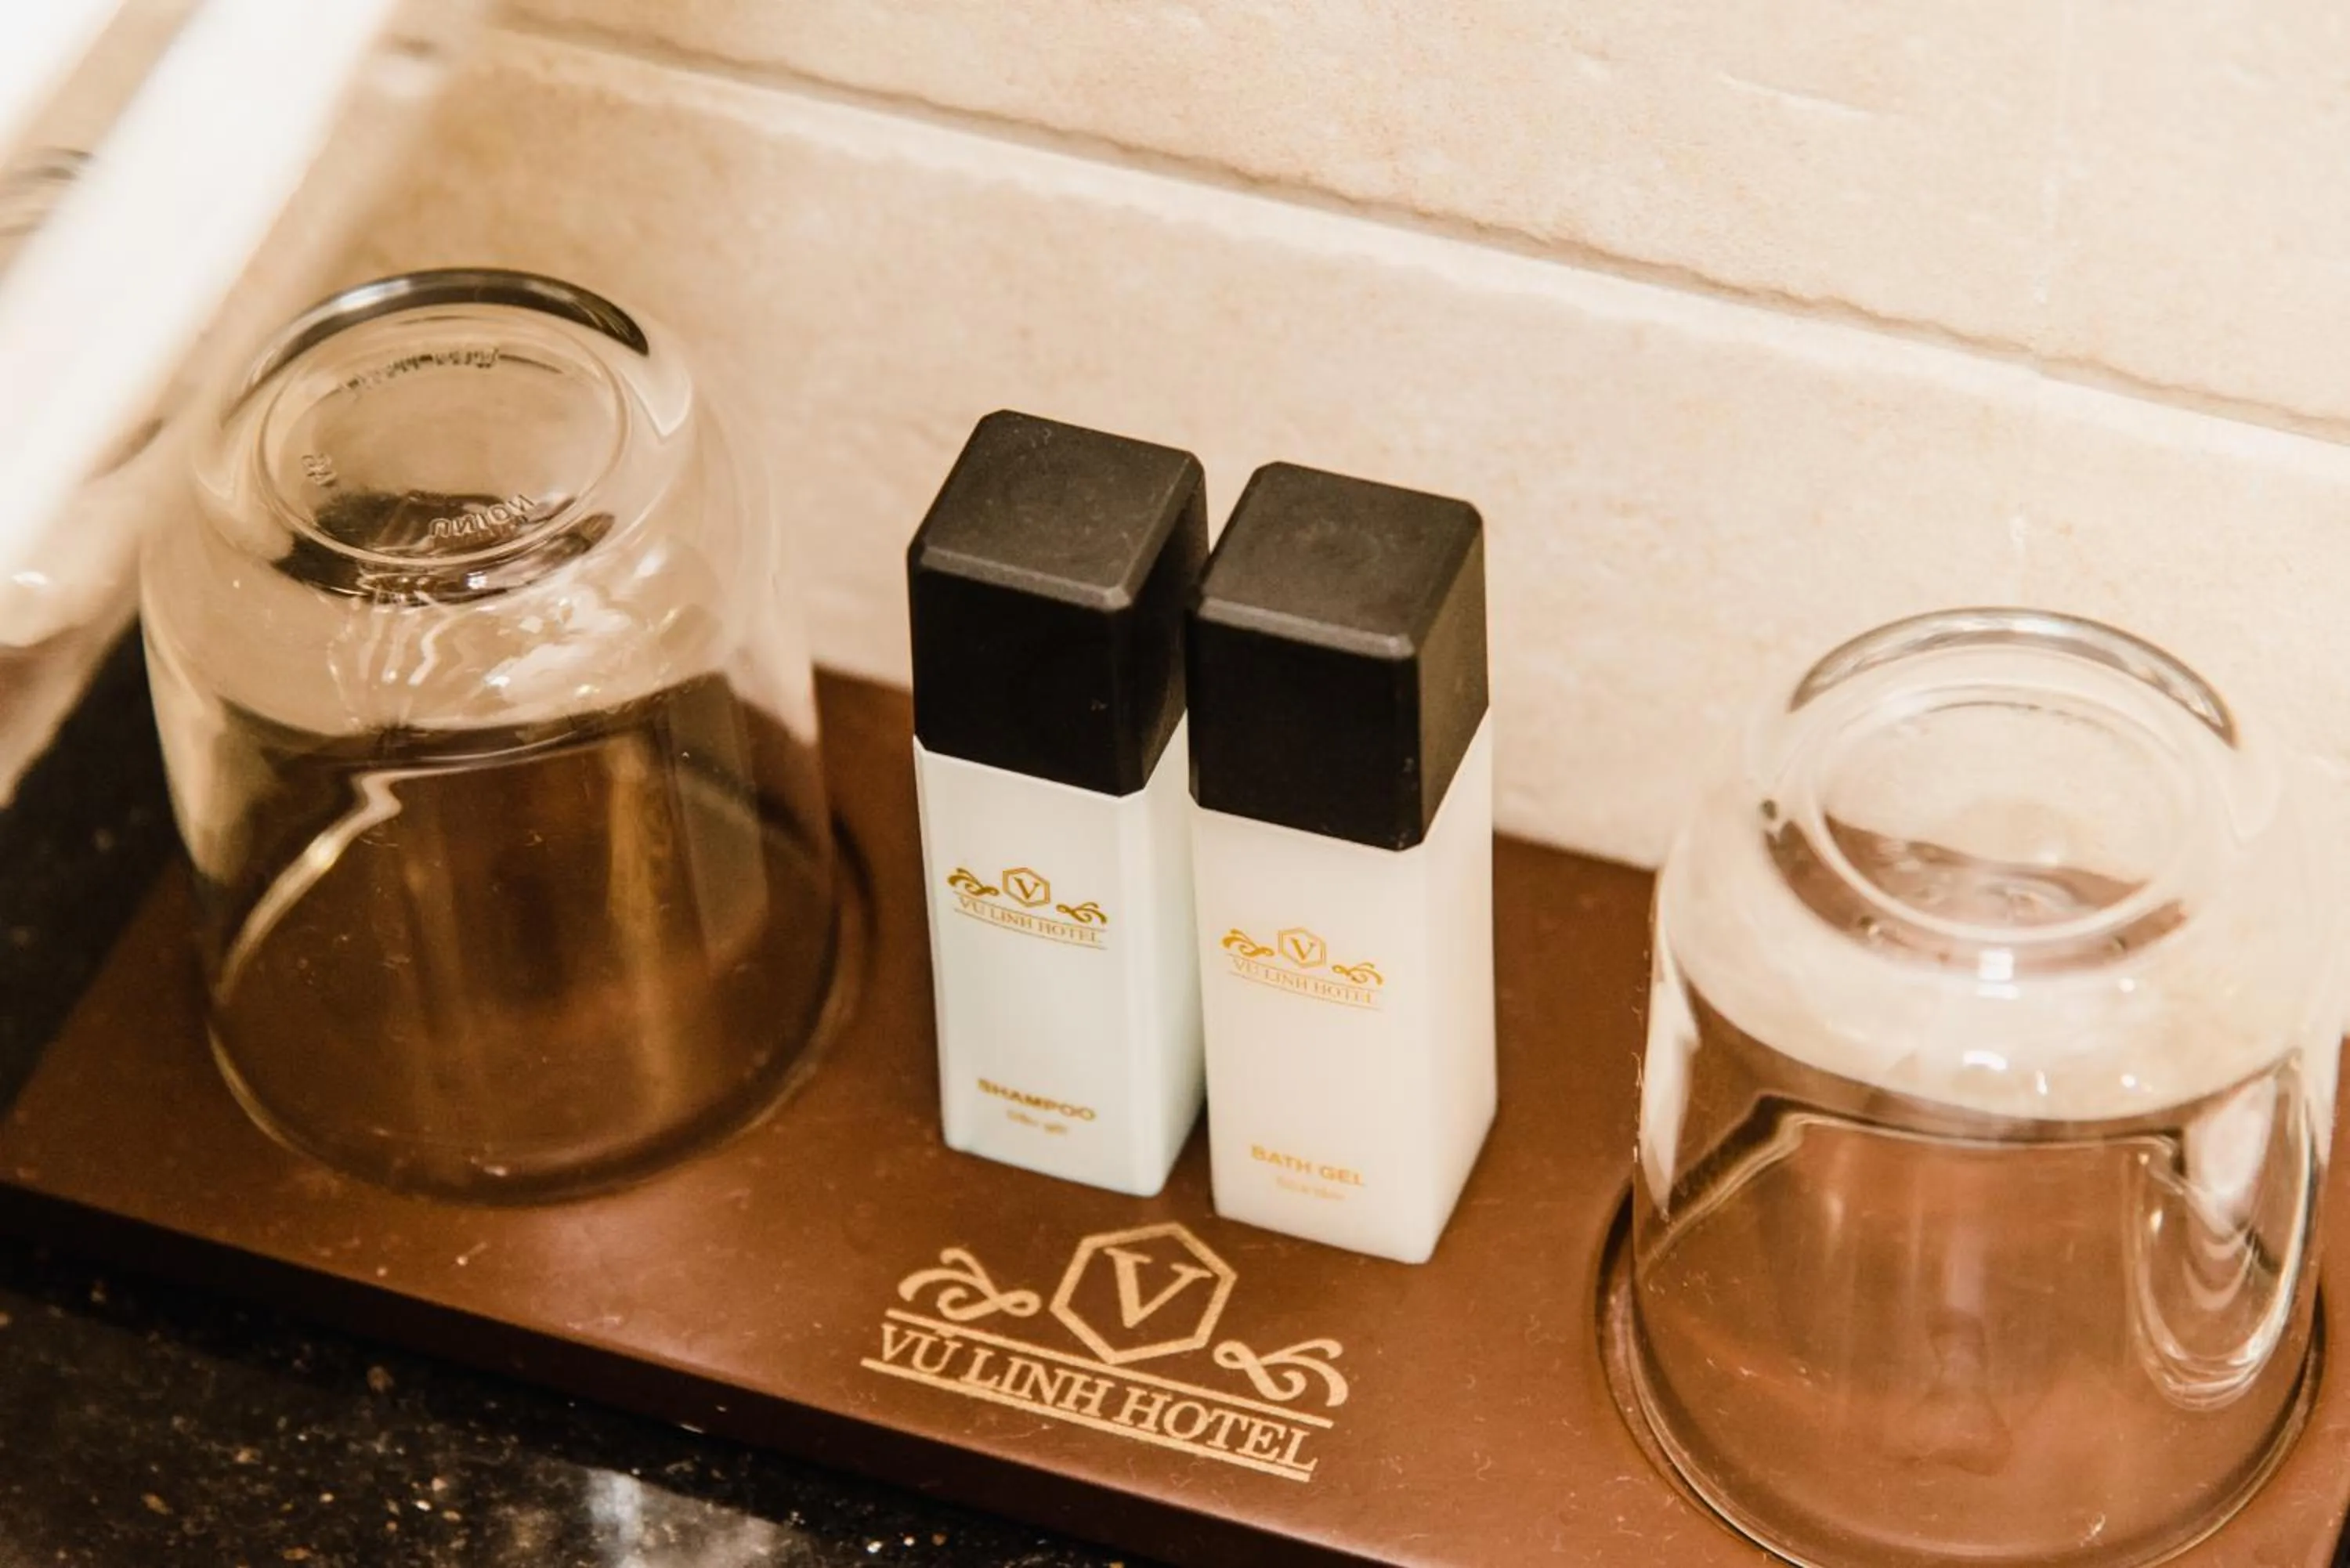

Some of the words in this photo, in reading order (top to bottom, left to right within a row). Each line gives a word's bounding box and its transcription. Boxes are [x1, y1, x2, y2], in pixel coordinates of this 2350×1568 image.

[1014, 876, 1040, 900] V
[990, 908, 1033, 929] LINH
[1038, 921, 1103, 943] HOTEL
[1290, 937, 1317, 961] V
[978, 1077, 1096, 1122] SHAMPOO
[1250, 1143, 1312, 1174] BATH
[1319, 1165, 1365, 1187] GEL
[1102, 1247, 1213, 1330] V
[960, 1347, 1108, 1418] LINH
[1112, 1386, 1319, 1472] HOTEL
